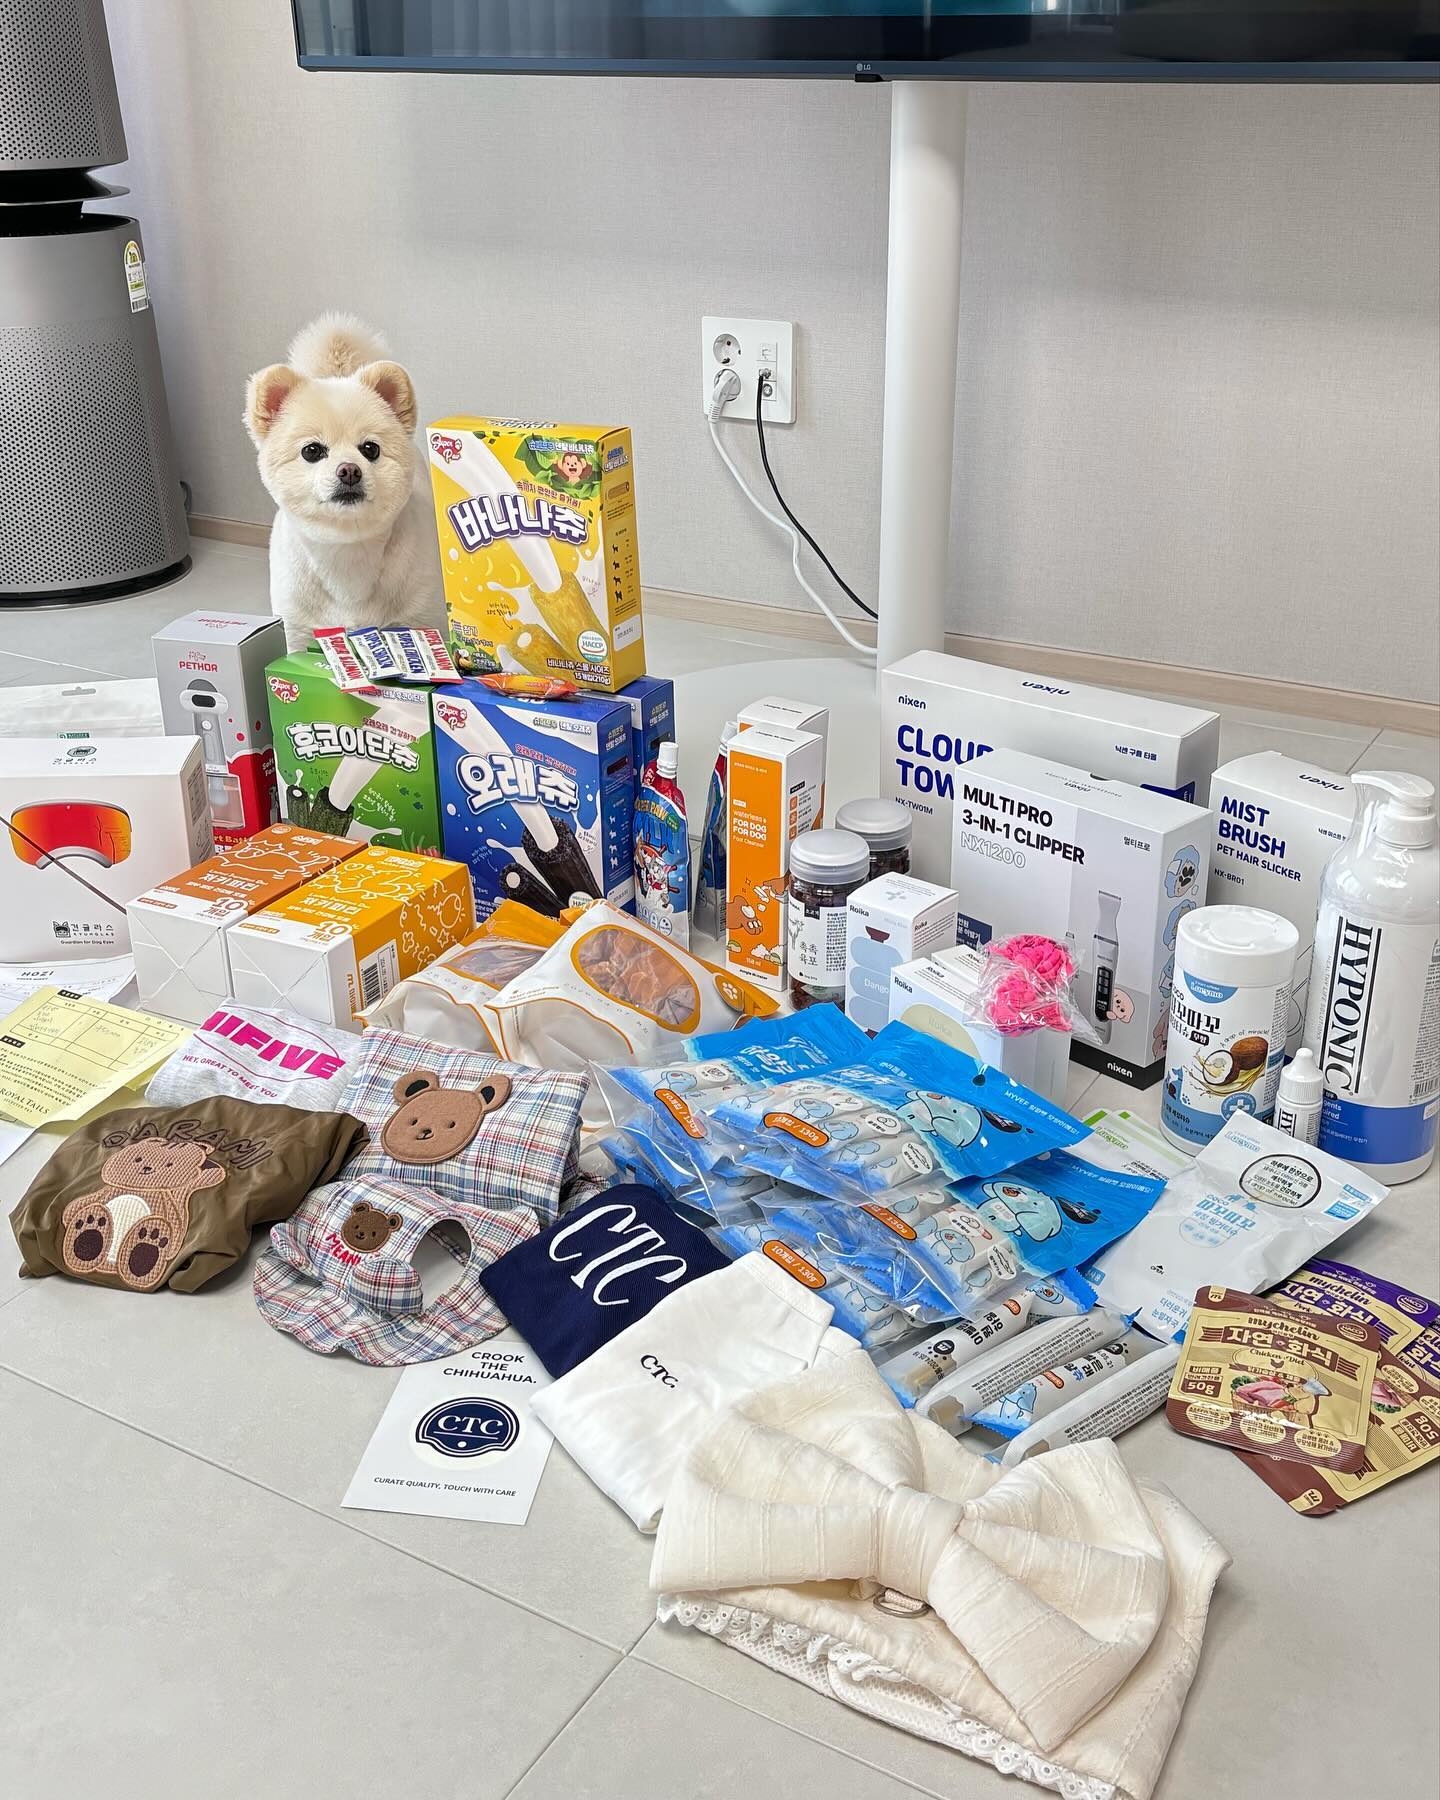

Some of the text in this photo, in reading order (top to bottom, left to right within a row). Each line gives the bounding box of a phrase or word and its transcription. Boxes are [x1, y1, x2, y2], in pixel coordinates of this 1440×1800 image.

[451, 495, 587, 548] 바나나츄
[582, 640, 604, 648] HACCP
[178, 661, 218, 673] PETHOR
[590, 664, 610, 674] 사이즈
[1022, 681, 1070, 695] nixen
[898, 695, 926, 710] nixen
[287, 723, 419, 771] 후코이단츄
[458, 755, 578, 811] 오래츄
[896, 758, 954, 800] TOW
[1299, 773, 1345, 793] nixen
[963, 784, 1016, 818] MULTI
[1017, 799, 1053, 827] PRO
[1221, 796, 1270, 827] MIST
[733, 818, 767, 832] FOR DOG
[733, 826, 767, 841] FOR DOG
[962, 809, 1085, 865] 3-IN-1 CLIPPER
[1123, 836, 1151, 851] 멀티프로
[1218, 819, 1286, 859] BRUSH
[960, 832, 1026, 868] NX1200
[1216, 844, 1301, 882] PET HAIR SLICKER
[1214, 868, 1245, 886] NX-BR01
[203, 906, 231, 917] 개입
[212, 898, 245, 911] 10
[850, 905, 870, 917] Roika
[71, 922, 114, 933] 견글라스
[315, 920, 349, 936] 10
[307, 931, 336, 943] 개입
[865, 979, 889, 994] Dango
[894, 976, 913, 993] Roika
[1323, 919, 1374, 1096] HYPONIC
[182, 1054, 278, 1098] HEY, GREAT TO MEET YOU
[1107, 1061, 1133, 1079] nixen
[799, 1128, 819, 1142] 130g
[549, 1203, 688, 1306] CTC
[770, 1244, 818, 1283] 10개입 130g
[1308, 1275, 1372, 1306] mychelin
[1281, 1282, 1322, 1303] 자연
[1327, 1300, 1374, 1327] 화식
[1247, 1316, 1320, 1342] mychelin
[1227, 1326, 1333, 1368] 자연 화식
[471, 1351, 525, 1363] CROOK
[1249, 1347, 1305, 1366] Chicken Diet
[480, 1361, 508, 1371] THE
[443, 1367, 537, 1384] CHIHUAHUA.
[1186, 1380, 1215, 1397] 50g
[437, 1415, 503, 1435] CTC
[1414, 1415, 1440, 1440] 50g
[373, 1476, 517, 1497] CURATE QUALITY, TOUCH WITH CARE
